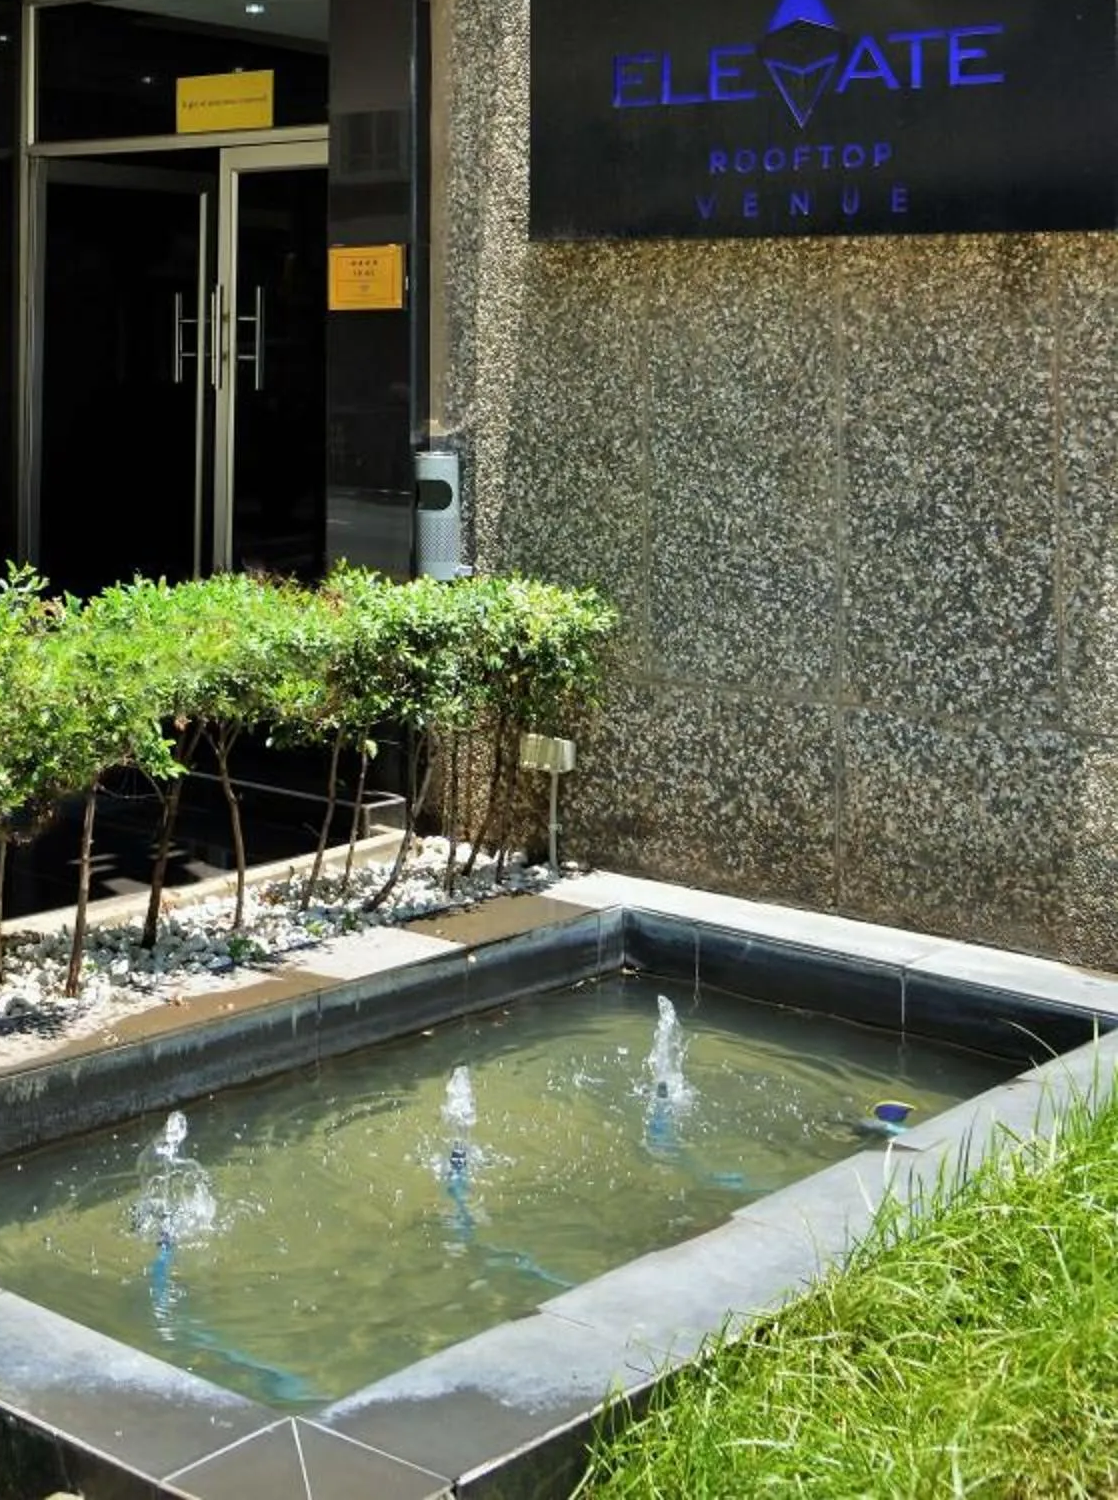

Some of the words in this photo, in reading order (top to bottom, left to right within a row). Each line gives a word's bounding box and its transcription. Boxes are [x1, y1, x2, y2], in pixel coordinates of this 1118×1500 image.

[612, 23, 1006, 129] ELEVATE
[709, 143, 895, 176] ROOFTOP
[695, 184, 910, 220] VENUE
